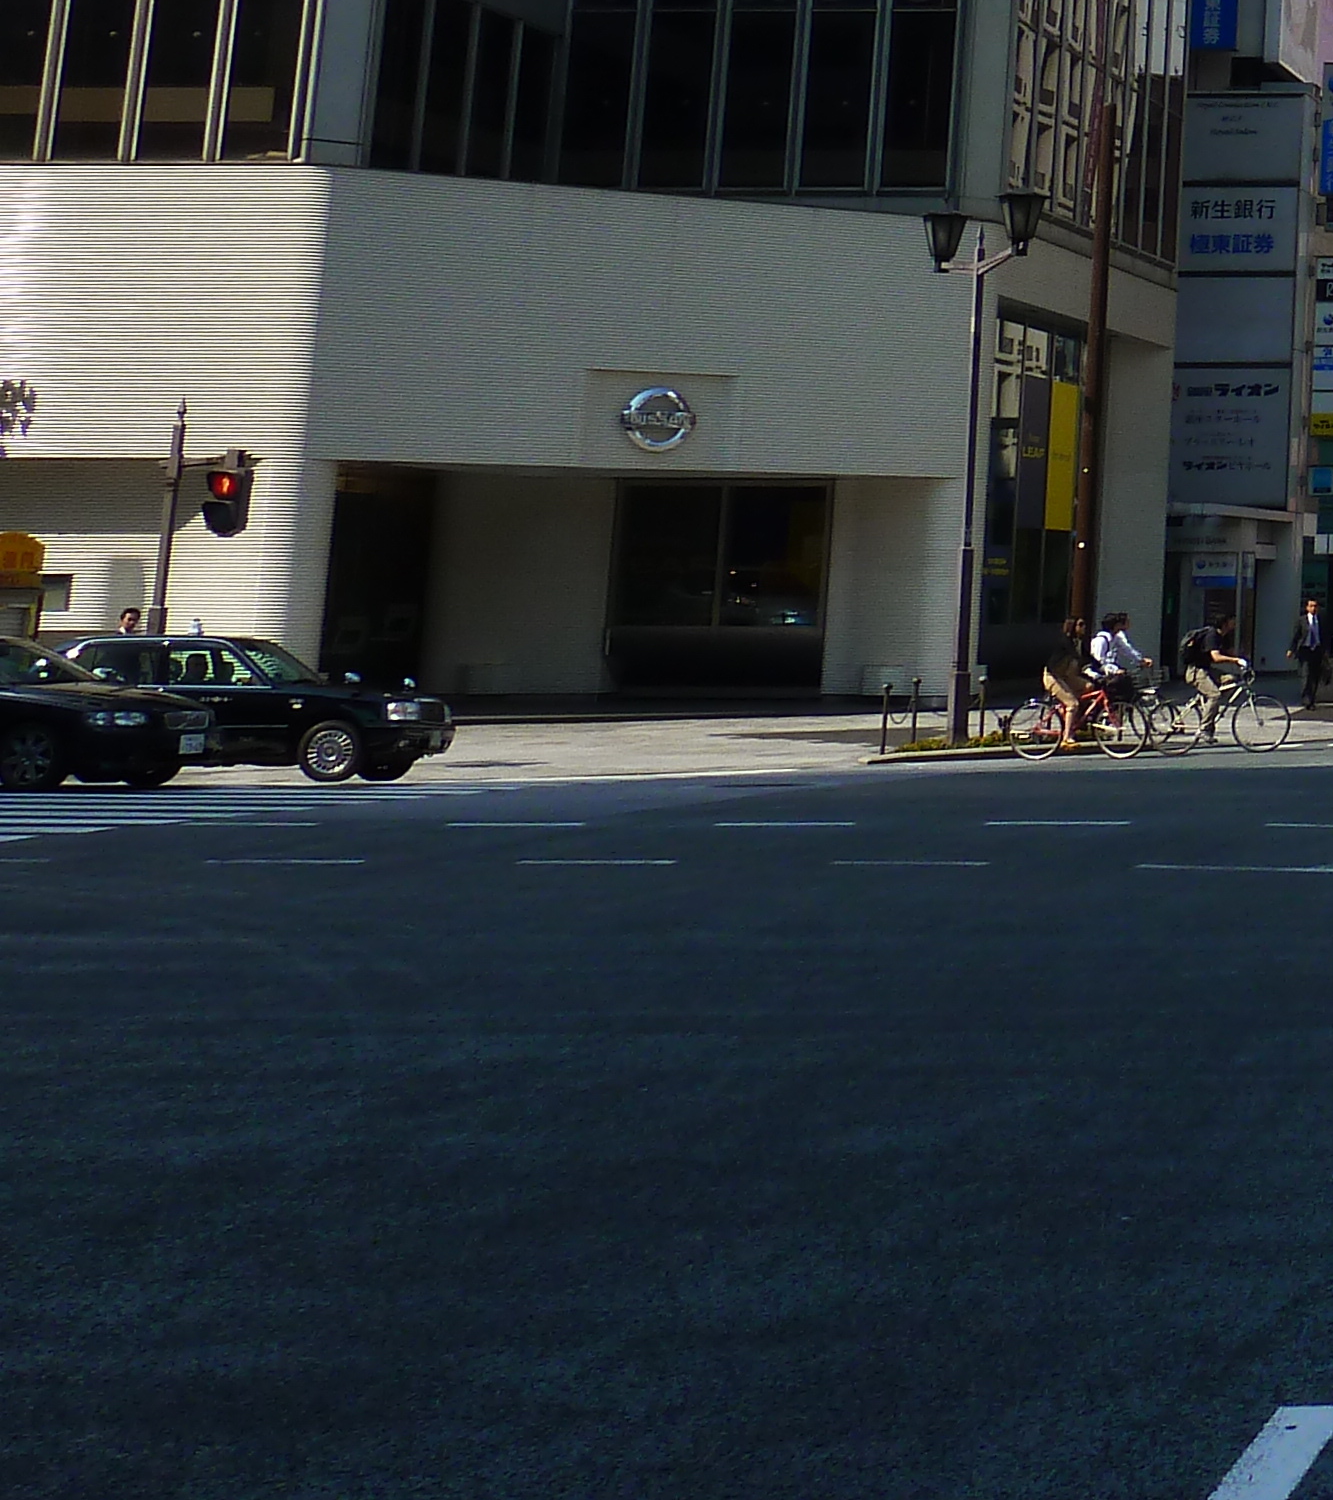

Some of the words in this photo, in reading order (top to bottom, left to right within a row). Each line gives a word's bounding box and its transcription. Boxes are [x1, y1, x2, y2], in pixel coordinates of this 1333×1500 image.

[1190, 199, 1276, 220] 新生銀行
[1189, 233, 1275, 255] 極東証券
